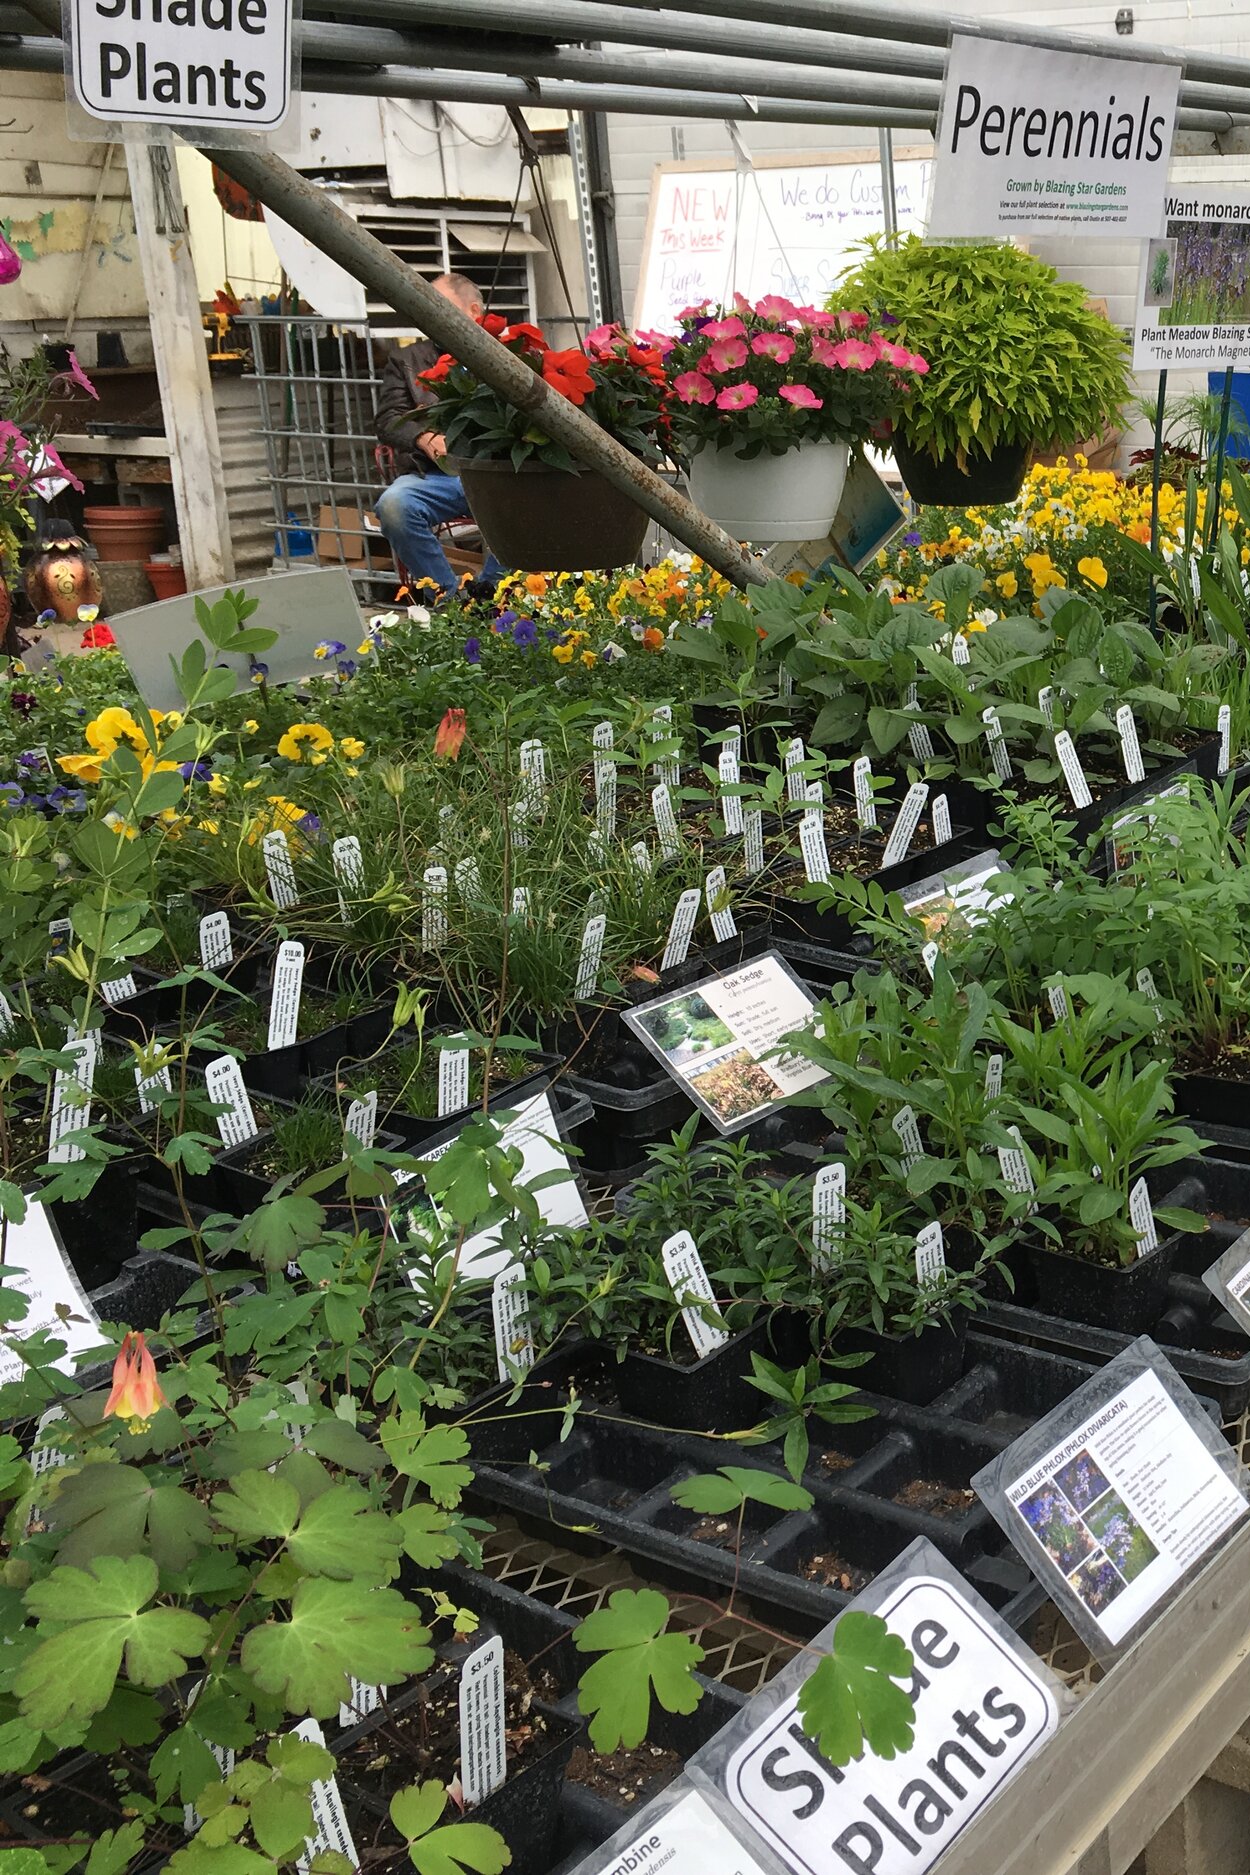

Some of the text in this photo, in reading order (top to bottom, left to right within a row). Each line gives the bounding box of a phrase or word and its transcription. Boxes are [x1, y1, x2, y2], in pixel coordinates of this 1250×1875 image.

[99, 42, 267, 111] Plants
[951, 84, 1165, 162] Perennials
[780, 176, 809, 206] We
[815, 174, 839, 204] do
[1006, 179, 1127, 196] Grown by Blazing Star Gardens
[672, 187, 732, 224] NEW
[1164, 197, 1198, 218] Want
[661, 257, 705, 291] Purple
[1141, 328, 1167, 342] Plant
[1169, 327, 1210, 342] Meadow
[1212, 326, 1245, 343] Blazing
[1175, 344, 1215, 359] Monarch
[205, 919, 222, 930] $4.00
[284, 949, 301, 957] $10.00
[722, 966, 764, 991] Oak Sedge
[212, 1065, 230, 1078] $4.00
[822, 1172, 839, 1184] $3.50
[670, 1241, 686, 1258] $3.50
[1008, 1399, 1129, 1503] WILD BLUE PHLOX (PHLOX DIVARICATA)
[471, 1651, 494, 1675] $3.50
[831, 1686, 1026, 1875] Plants
[322, 1790, 341, 1828] (Aquilegia
